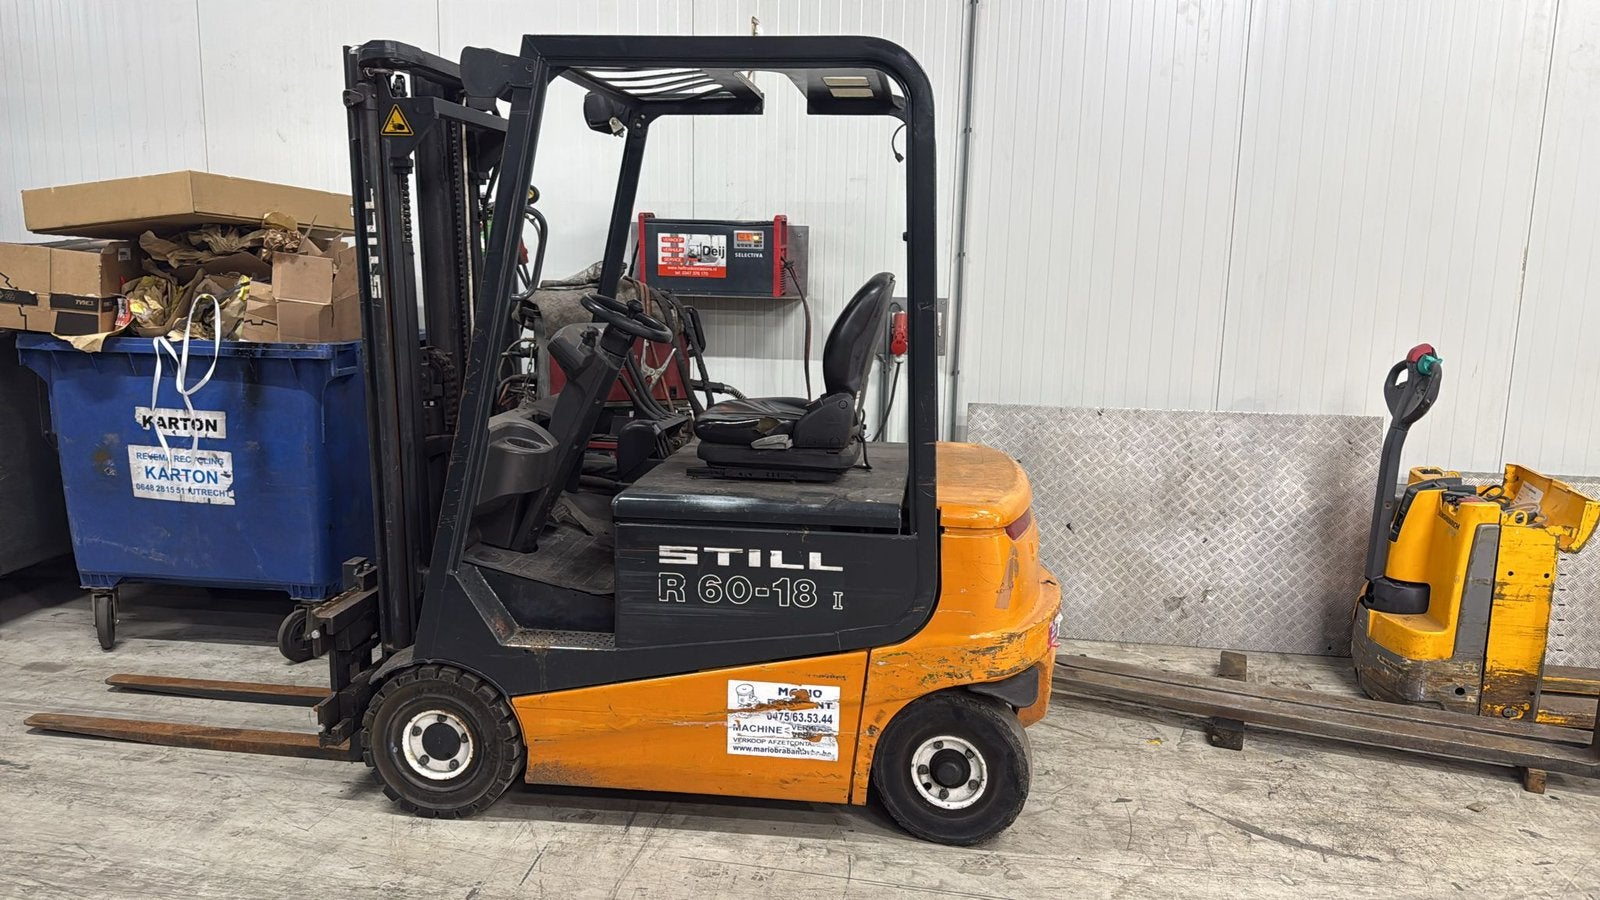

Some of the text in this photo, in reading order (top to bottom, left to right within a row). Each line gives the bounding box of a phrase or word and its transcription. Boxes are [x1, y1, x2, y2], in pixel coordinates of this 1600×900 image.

[365, 188, 381, 299] STILL
[702, 246, 725, 259] Deij
[142, 415, 217, 432] KARTON
[174, 454, 224, 466] RECCLING
[145, 466, 218, 484] KARTON
[658, 545, 844, 571] STILL
[658, 572, 686, 602] R
[698, 574, 818, 608] 60-18
